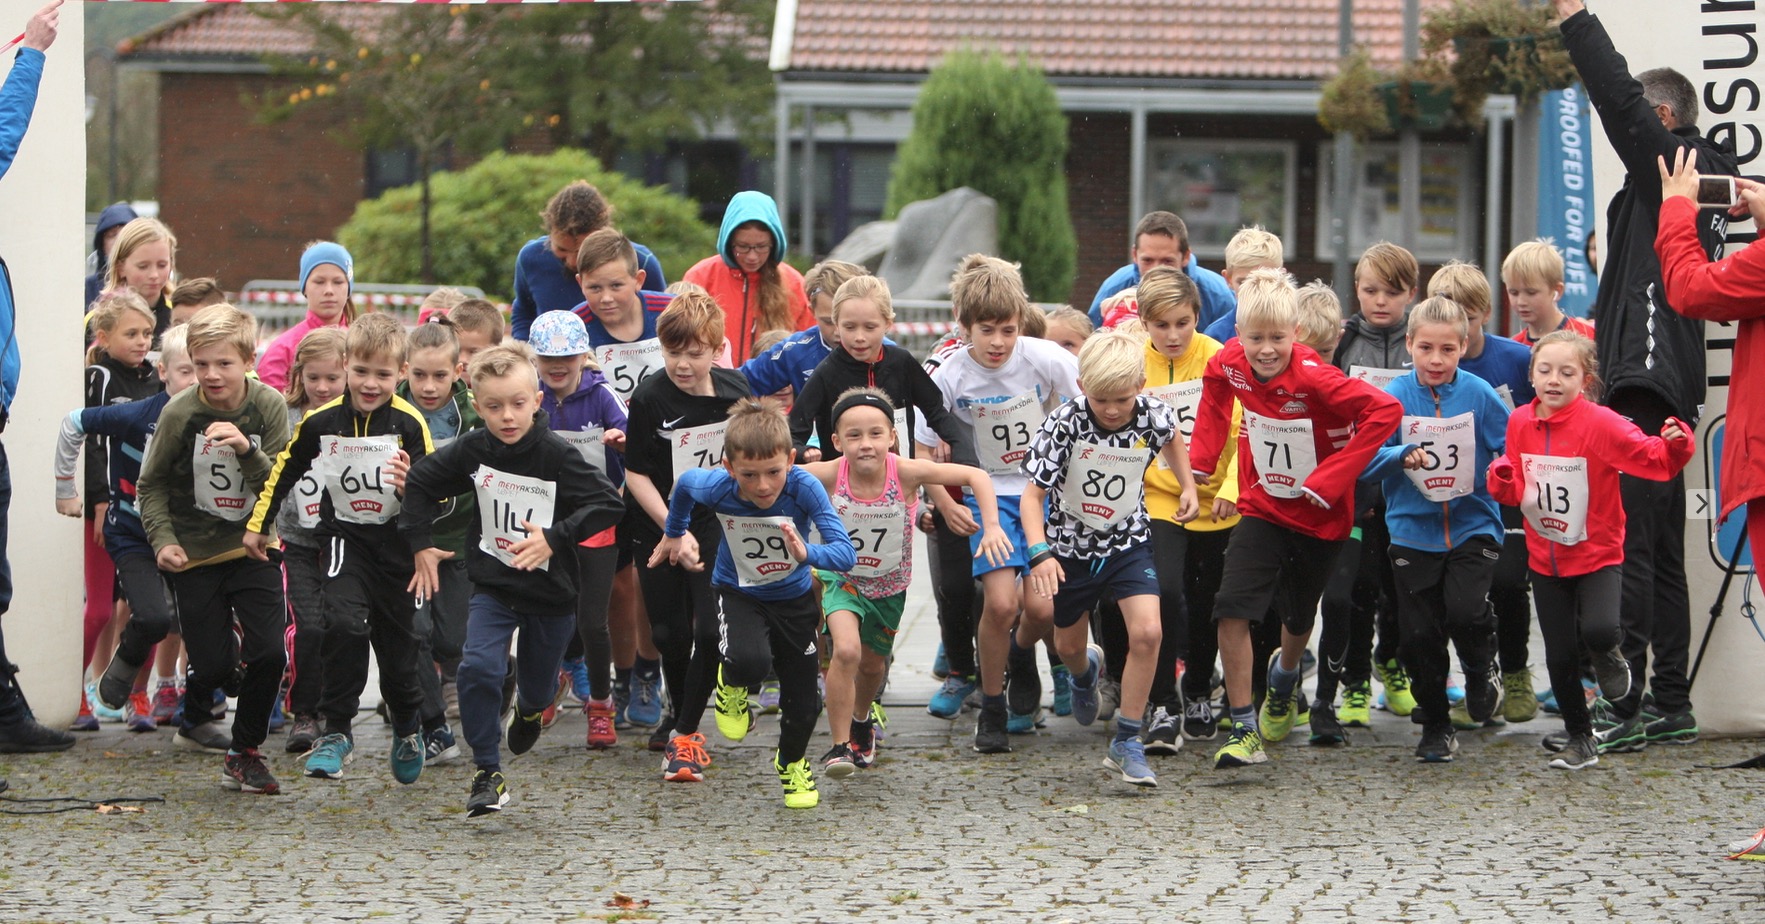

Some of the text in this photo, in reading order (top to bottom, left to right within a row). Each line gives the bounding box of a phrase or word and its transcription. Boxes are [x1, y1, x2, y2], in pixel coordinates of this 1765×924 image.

[1564, 194, 1585, 243] FOR
[1564, 246, 1588, 297] LIFE
[991, 421, 1030, 451] 93
[693, 445, 725, 468] 74
[1263, 441, 1292, 470] 71
[1420, 441, 1459, 471] 53
[340, 465, 383, 494] 64
[1082, 469, 1126, 501] 80
[1267, 475, 1293, 485] MENY
[1428, 478, 1453, 487] MENY
[217, 500, 245, 508] MENY
[353, 501, 380, 510] MENY
[1536, 481, 1570, 514] 113
[493, 499, 534, 538] 114
[1084, 505, 1112, 517] MENY
[1542, 519, 1566, 530] MENY
[742, 536, 789, 560] 29
[847, 528, 888, 553] 67
[760, 564, 789, 573] MENY
[858, 558, 879, 566] ENY
